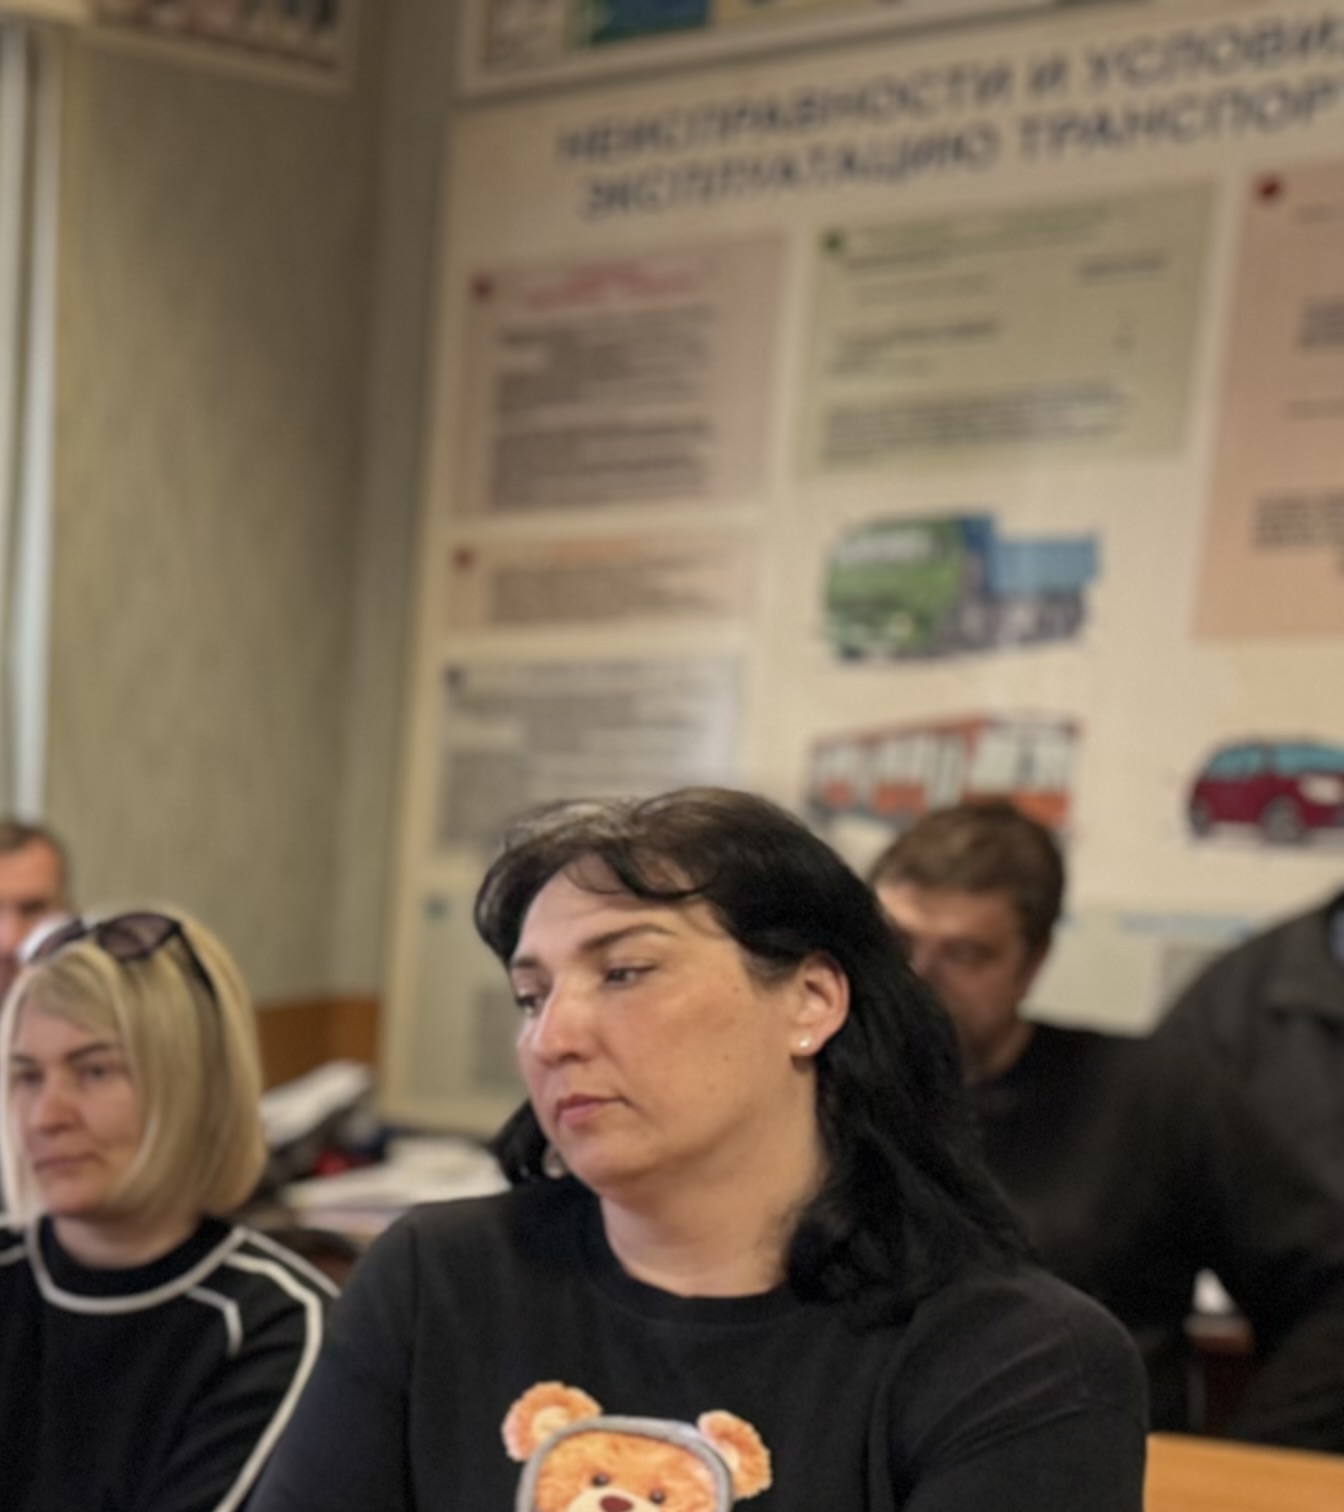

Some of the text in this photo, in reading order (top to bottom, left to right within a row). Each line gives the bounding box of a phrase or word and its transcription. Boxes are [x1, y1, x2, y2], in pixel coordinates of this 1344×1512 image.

[1029, 50, 1069, 97] И
[1084, 12, 1343, 93] УСЛОВИ
[1020, 74, 1343, 162] ТРАНСПОР
